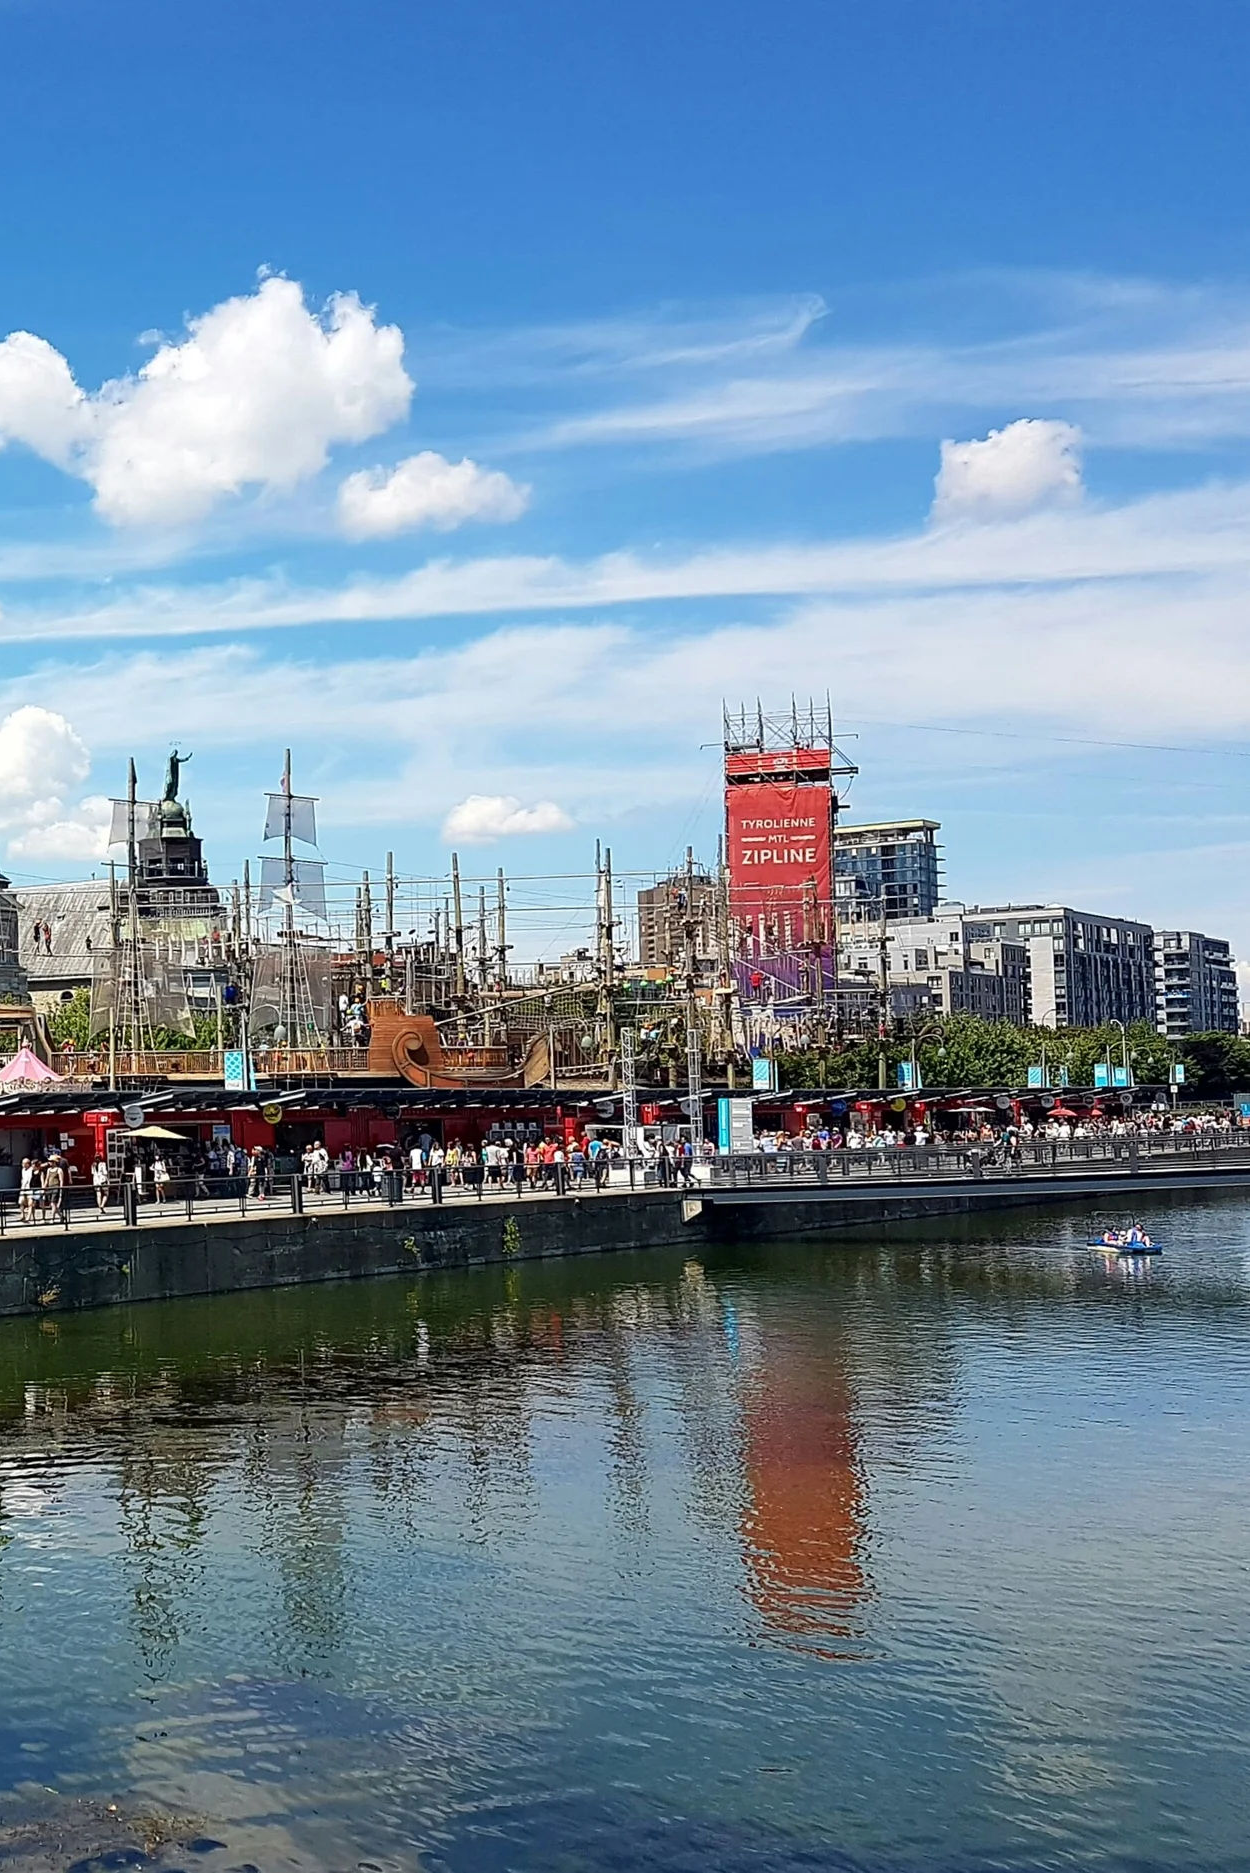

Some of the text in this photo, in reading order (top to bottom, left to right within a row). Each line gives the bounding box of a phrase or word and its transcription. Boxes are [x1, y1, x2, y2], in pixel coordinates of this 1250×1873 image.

[740, 817, 816, 830] TYROLIENNE
[767, 834, 790, 844] MTL
[741, 847, 817, 865] ZIPLINE
